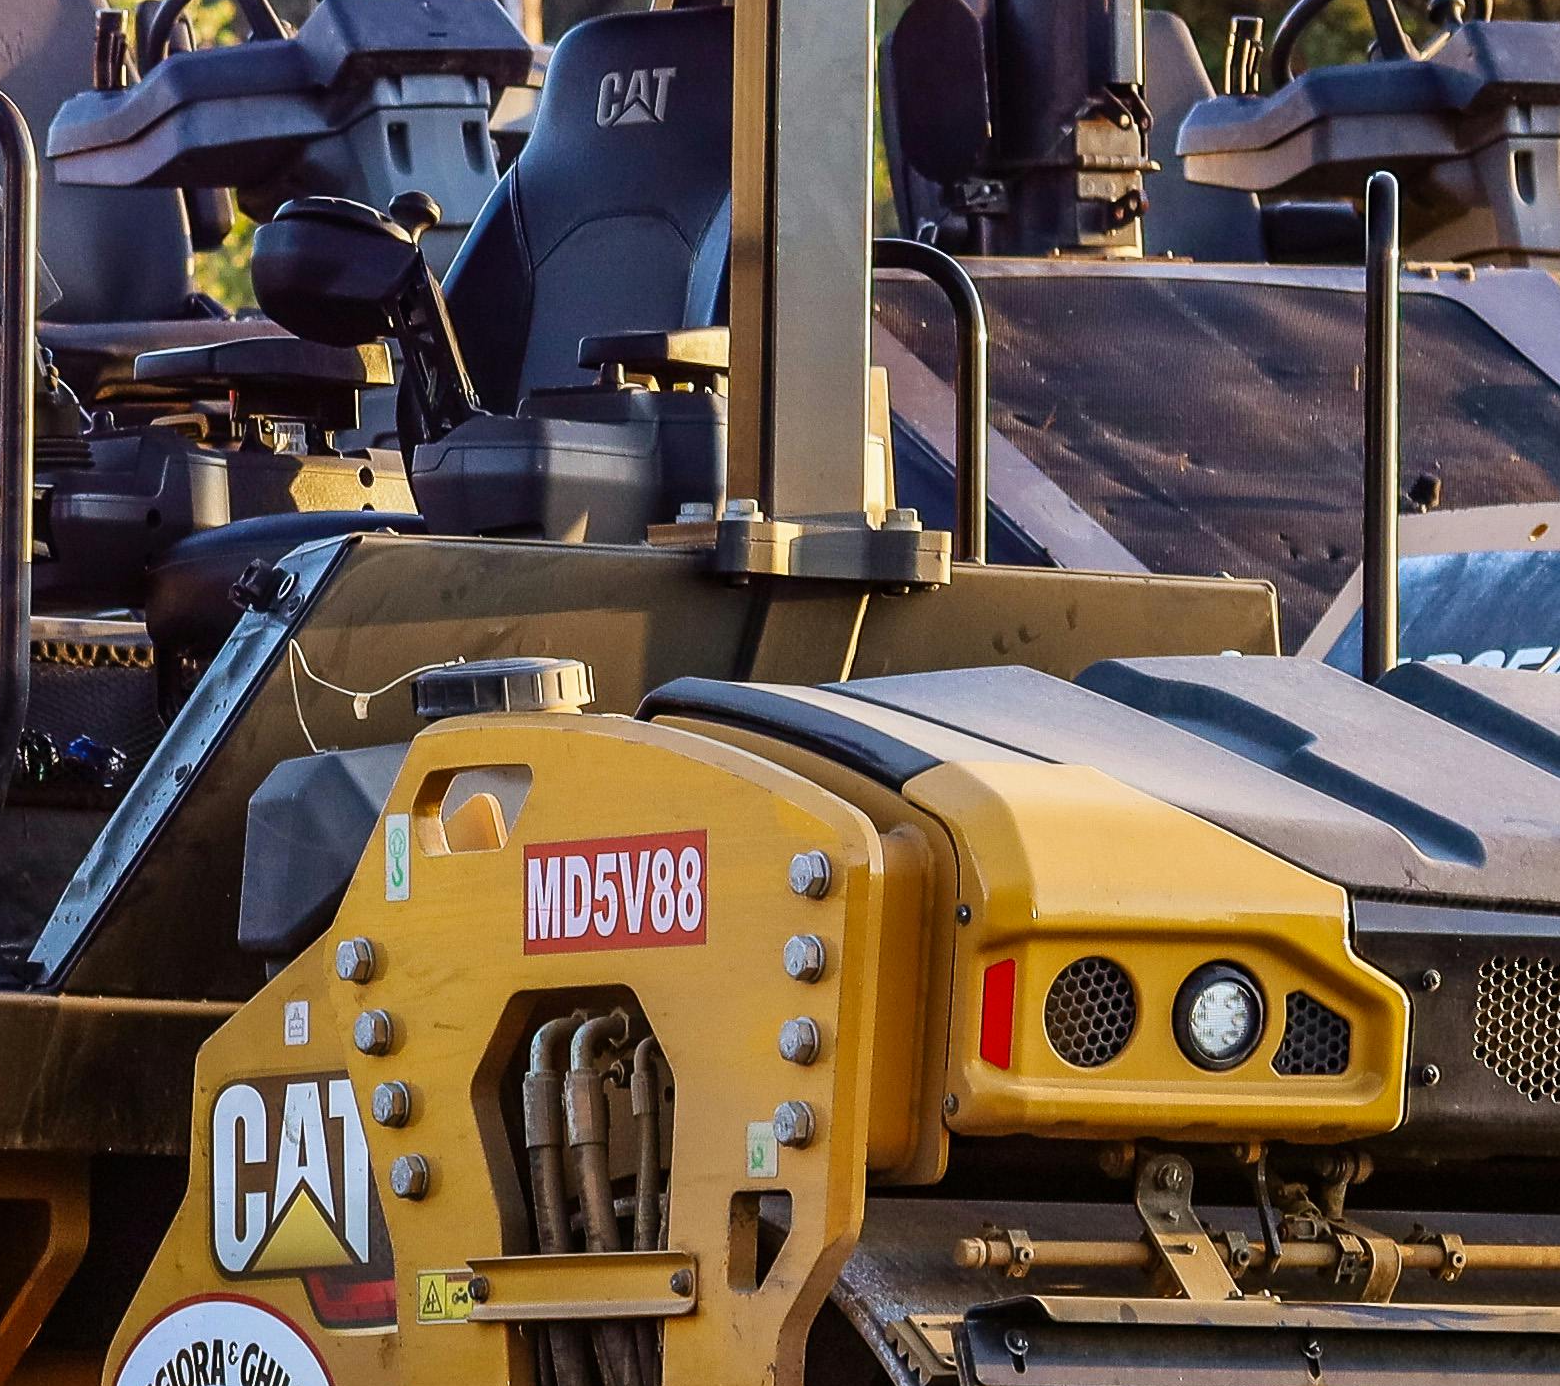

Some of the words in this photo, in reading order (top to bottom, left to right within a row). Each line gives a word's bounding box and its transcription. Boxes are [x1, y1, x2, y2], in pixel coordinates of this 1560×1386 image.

[596, 66, 677, 127] CAT
[527, 845, 702, 941] MD5V88
[227, 1341, 239, 1365] &
